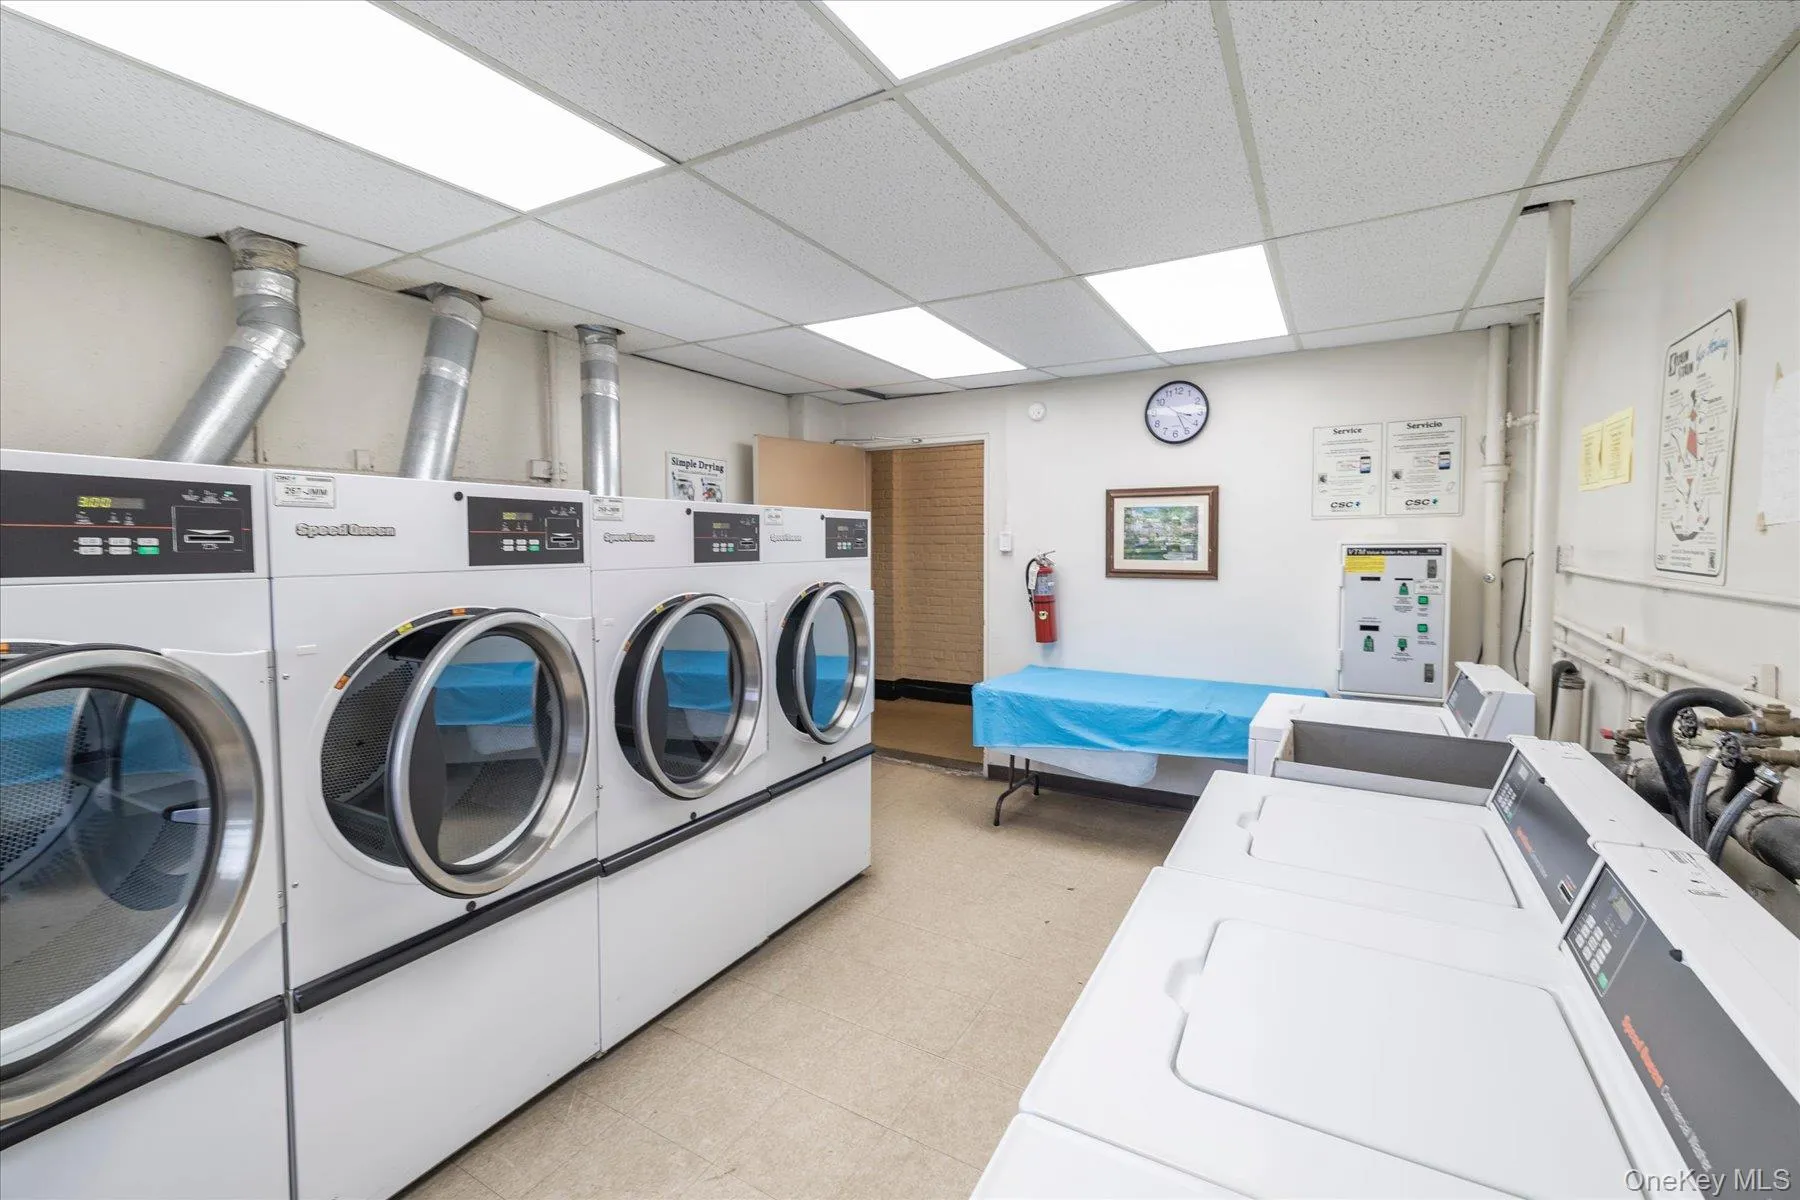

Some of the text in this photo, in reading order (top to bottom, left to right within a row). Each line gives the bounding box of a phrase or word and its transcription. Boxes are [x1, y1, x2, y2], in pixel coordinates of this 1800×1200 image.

[1174, 386, 1184, 395] 12
[1156, 398, 1165, 406] 10
[1194, 396, 1201, 405] 2
[1154, 419, 1160, 428] 8
[1406, 420, 1443, 430] Servicio
[1162, 427, 1168, 435] 7
[1172, 430, 1179, 438] 6
[1184, 426, 1190, 435] 5
[1332, 426, 1362, 436] Service
[671, 456, 697, 470] Simple
[698, 460, 724, 474] Drying
[1330, 501, 1354, 509] CSC
[1405, 498, 1430, 507] CSC
[295, 522, 396, 539] Speed Queen
